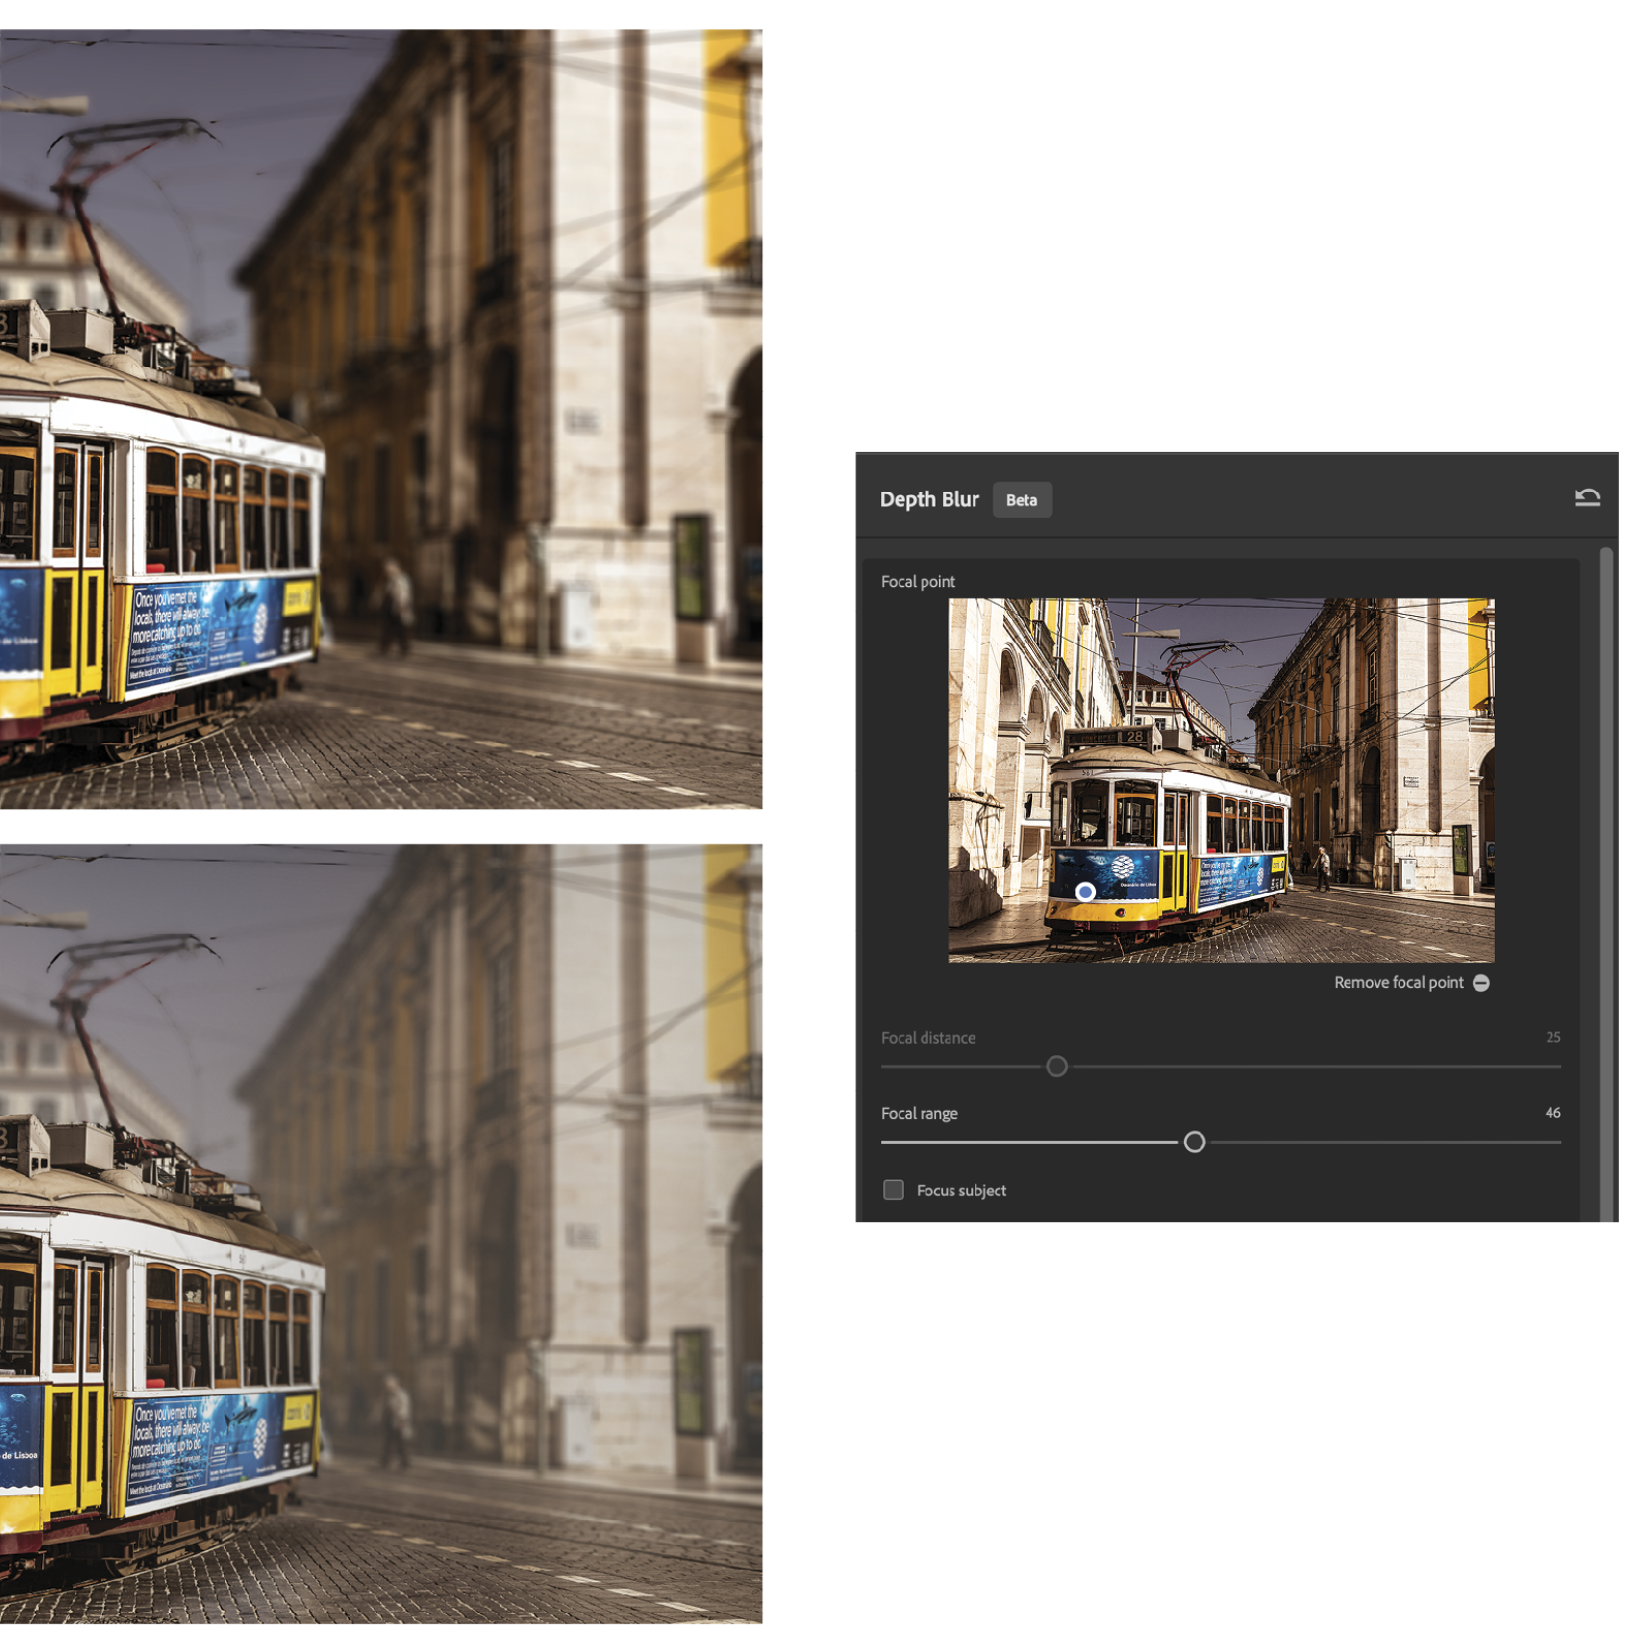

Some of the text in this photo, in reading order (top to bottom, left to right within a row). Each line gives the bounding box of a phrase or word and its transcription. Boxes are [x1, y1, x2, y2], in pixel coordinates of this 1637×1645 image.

[880, 490, 980, 512] Depth Blur
[1006, 493, 1038, 507] Beta
[881, 574, 956, 592] Focal point
[135, 592, 154, 608] Once
[176, 591, 187, 604] met
[187, 590, 197, 603] the
[134, 605, 211, 626] locals, there will always be
[133, 629, 151, 644] more
[152, 624, 177, 642] catching
[179, 625, 185, 640] up
[187, 623, 193, 636] to
[1127, 731, 1144, 742] 28
[1335, 974, 1465, 993] Remove focal point
[881, 1030, 976, 1045] Focal distance
[1546, 1030, 1561, 1044] 25
[881, 1106, 959, 1123] Focal range
[1545, 1106, 1561, 1119] 46
[917, 1183, 1007, 1201] Focus subject
[135, 1406, 154, 1422] Once
[176, 1405, 187, 1418] met
[187, 1404, 197, 1417] the
[134, 1419, 211, 1440] locals, there will always be
[3, 1452, 12, 1460] de
[133, 1443, 151, 1458] more
[152, 1438, 177, 1456] catching
[179, 1439, 185, 1454] up
[187, 1437, 193, 1450] to
